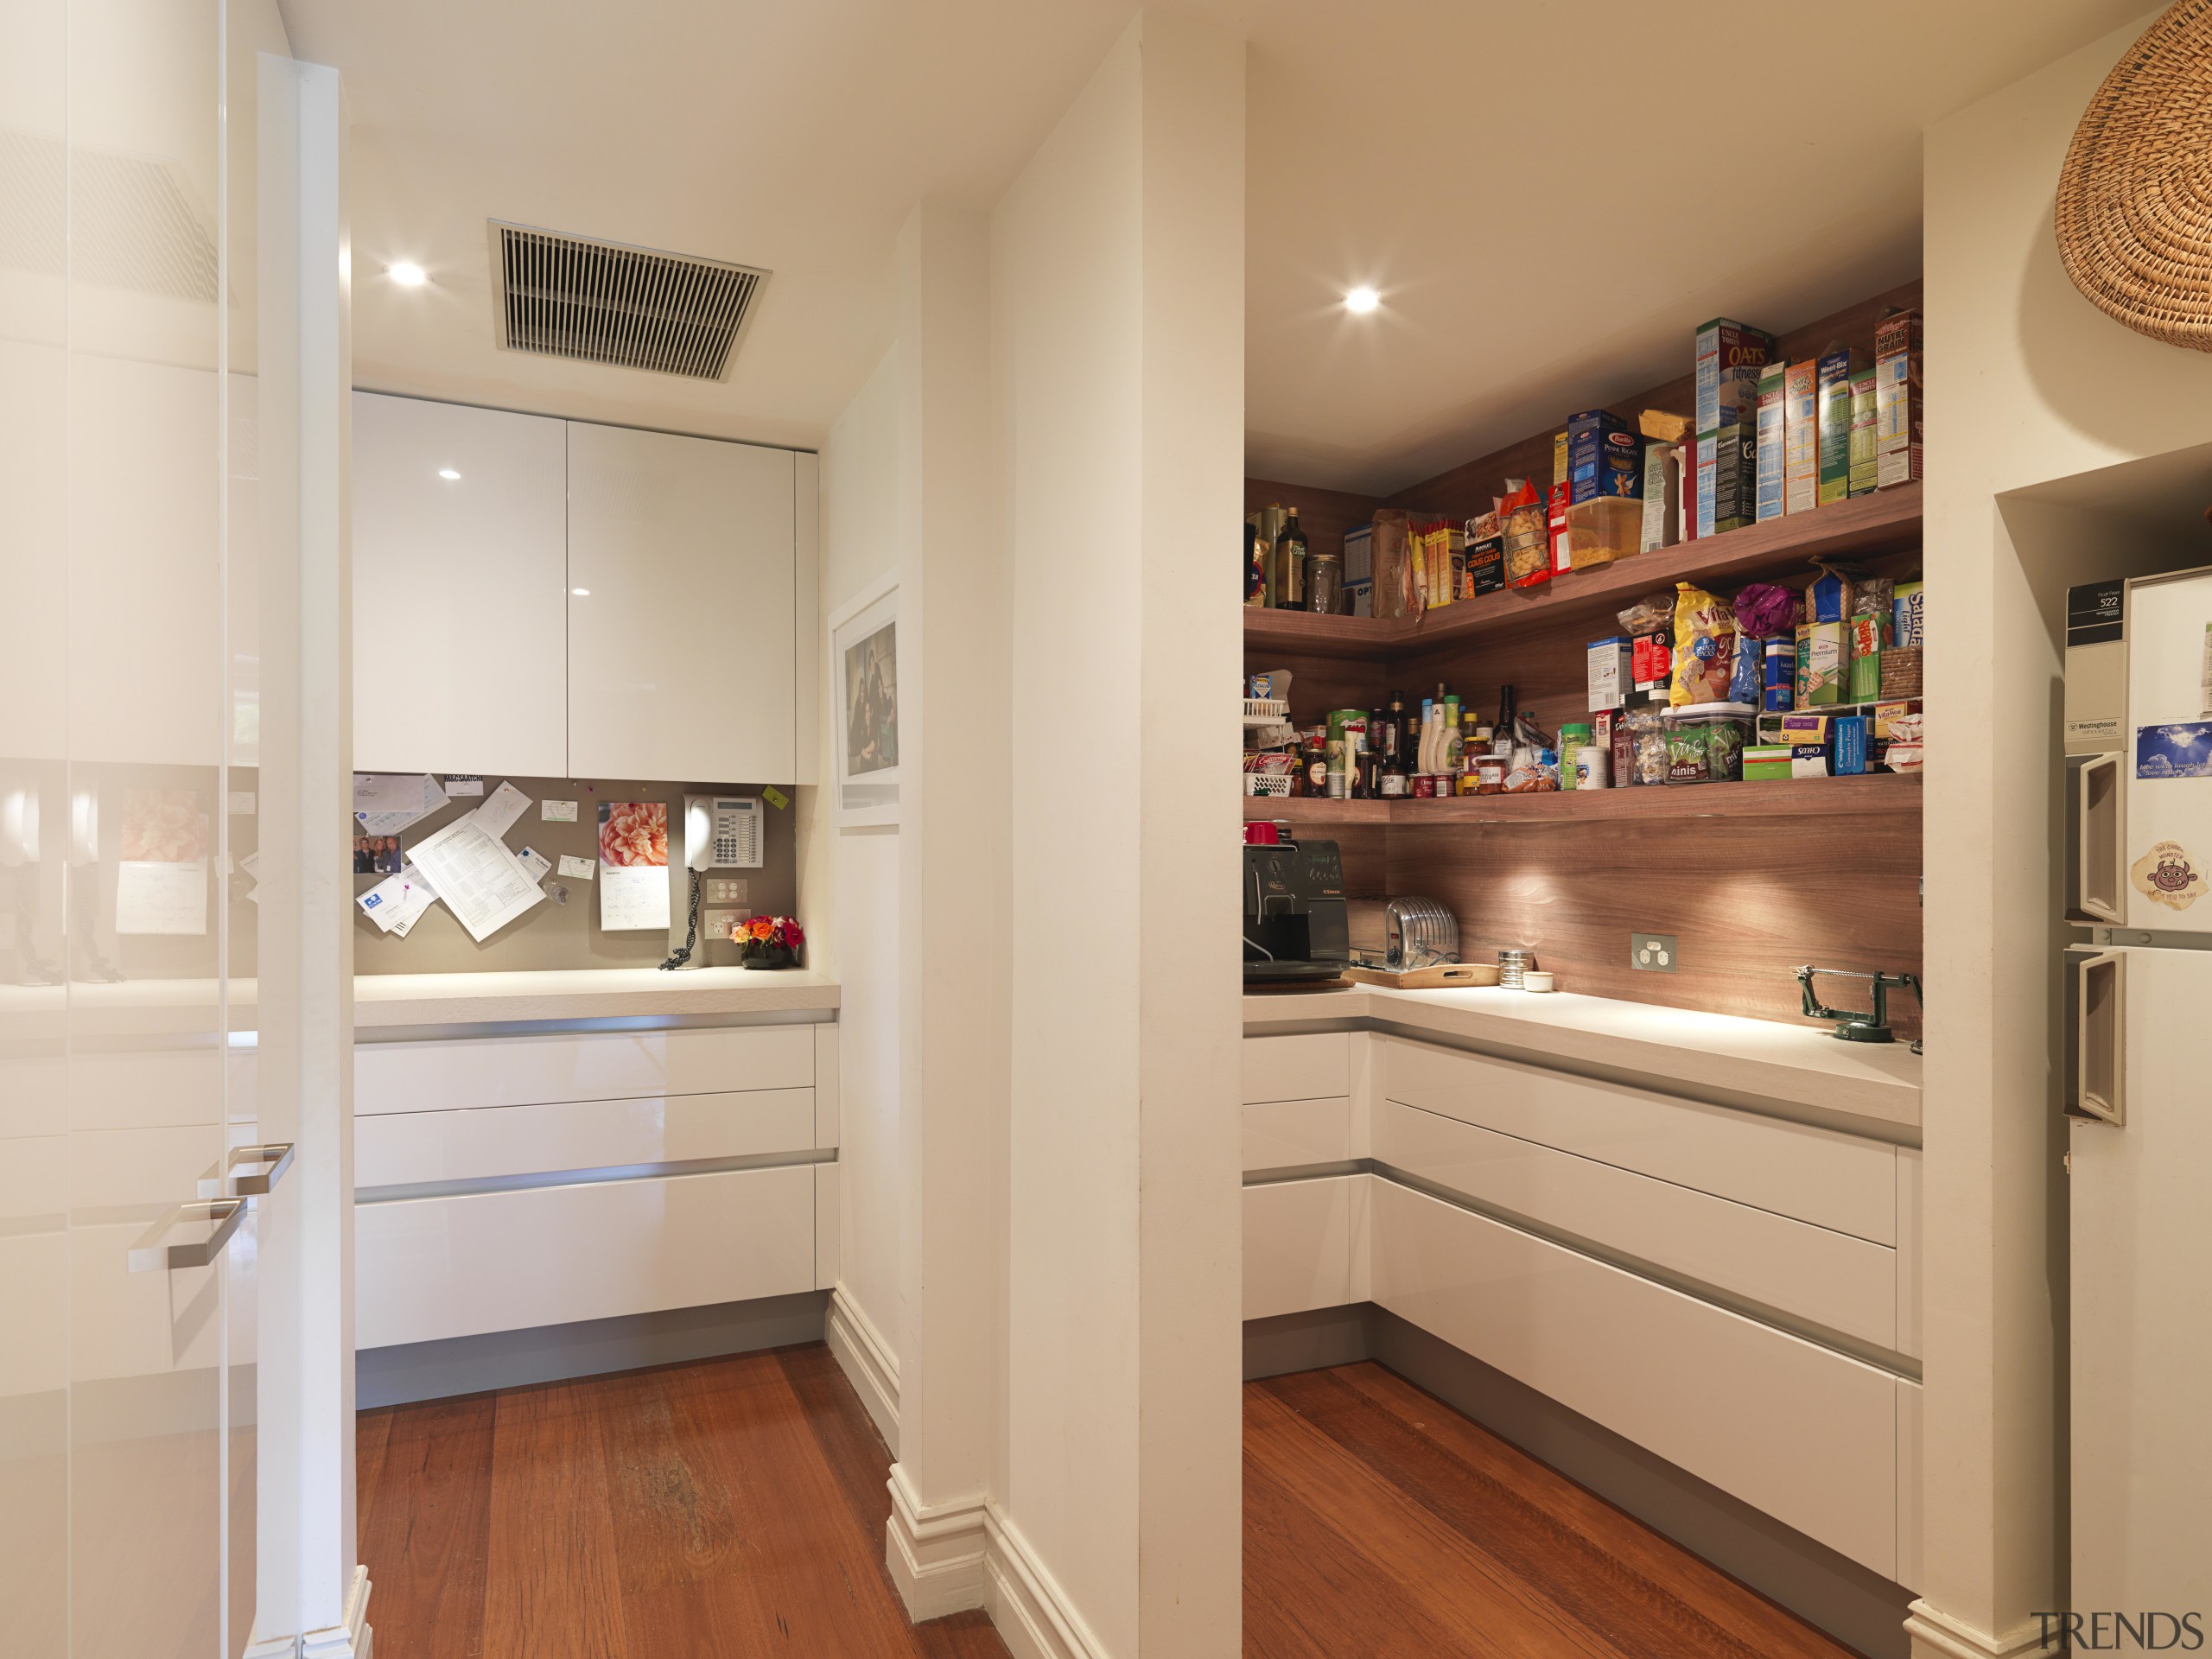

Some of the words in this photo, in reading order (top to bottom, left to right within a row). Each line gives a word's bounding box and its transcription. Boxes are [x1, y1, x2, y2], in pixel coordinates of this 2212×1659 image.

[1721, 328, 1739, 339] UNCLE
[1877, 329, 1905, 346] NUTRI
[1721, 336, 1740, 346] TOBYS
[1877, 337, 1904, 353] GRAIN
[1728, 346, 1765, 365] OATS
[1821, 360, 1847, 374] Weet-Bix
[1732, 365, 1762, 382] fitness
[1859, 378, 1876, 388] UNCLE
[1762, 390, 1781, 400] UNCLE
[1614, 435, 1631, 443] Barilla
[1604, 443, 1620, 453] PENNE
[1621, 447, 1639, 455] RIGATE
[1467, 558, 1484, 569] COUS
[1484, 552, 1500, 563] COUS
[2101, 597, 2118, 607] 522
[1902, 610, 1911, 632] Light
[1811, 648, 1838, 657] Premium
[1797, 747, 1821, 755] CHEDS
